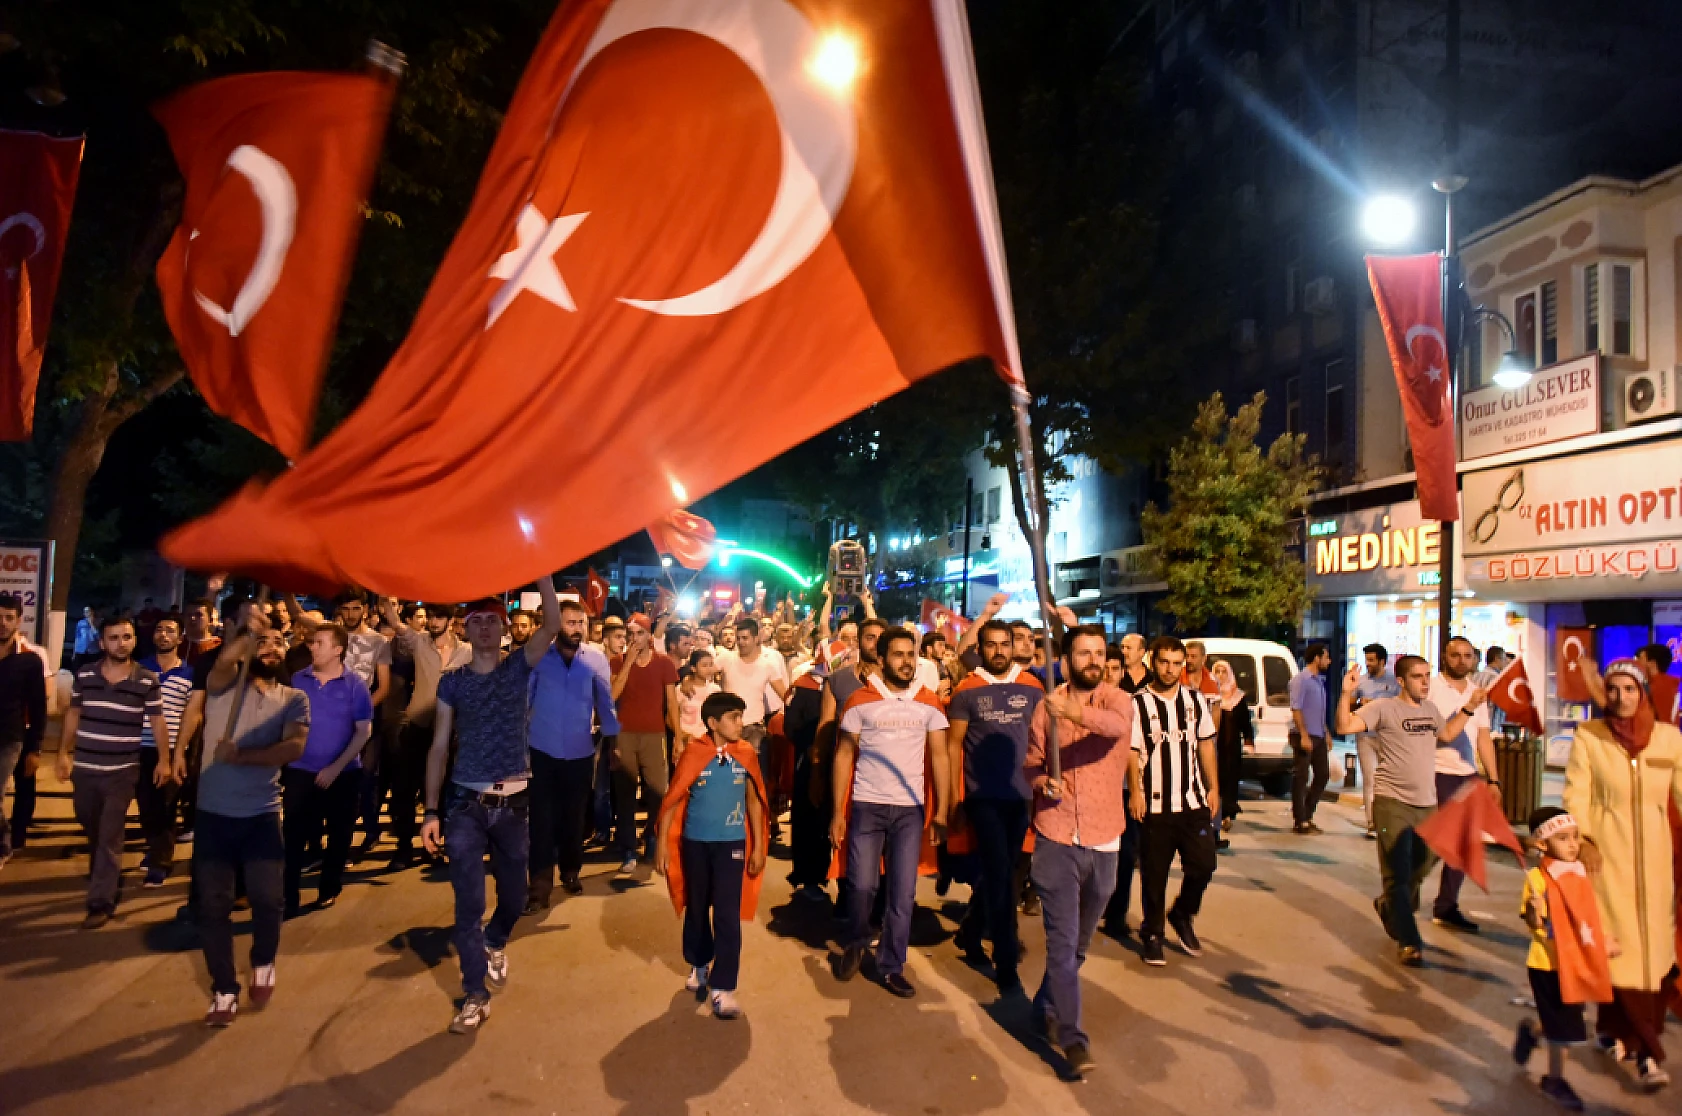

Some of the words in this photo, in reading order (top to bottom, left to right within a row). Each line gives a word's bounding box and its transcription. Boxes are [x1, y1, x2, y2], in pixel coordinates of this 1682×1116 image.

[1465, 400, 1498, 422] Onur
[1536, 495, 1607, 535] ALTIN
[1316, 515, 1440, 575] MEDİNE
[1488, 542, 1677, 581] GÖZLÜKÇÜ
